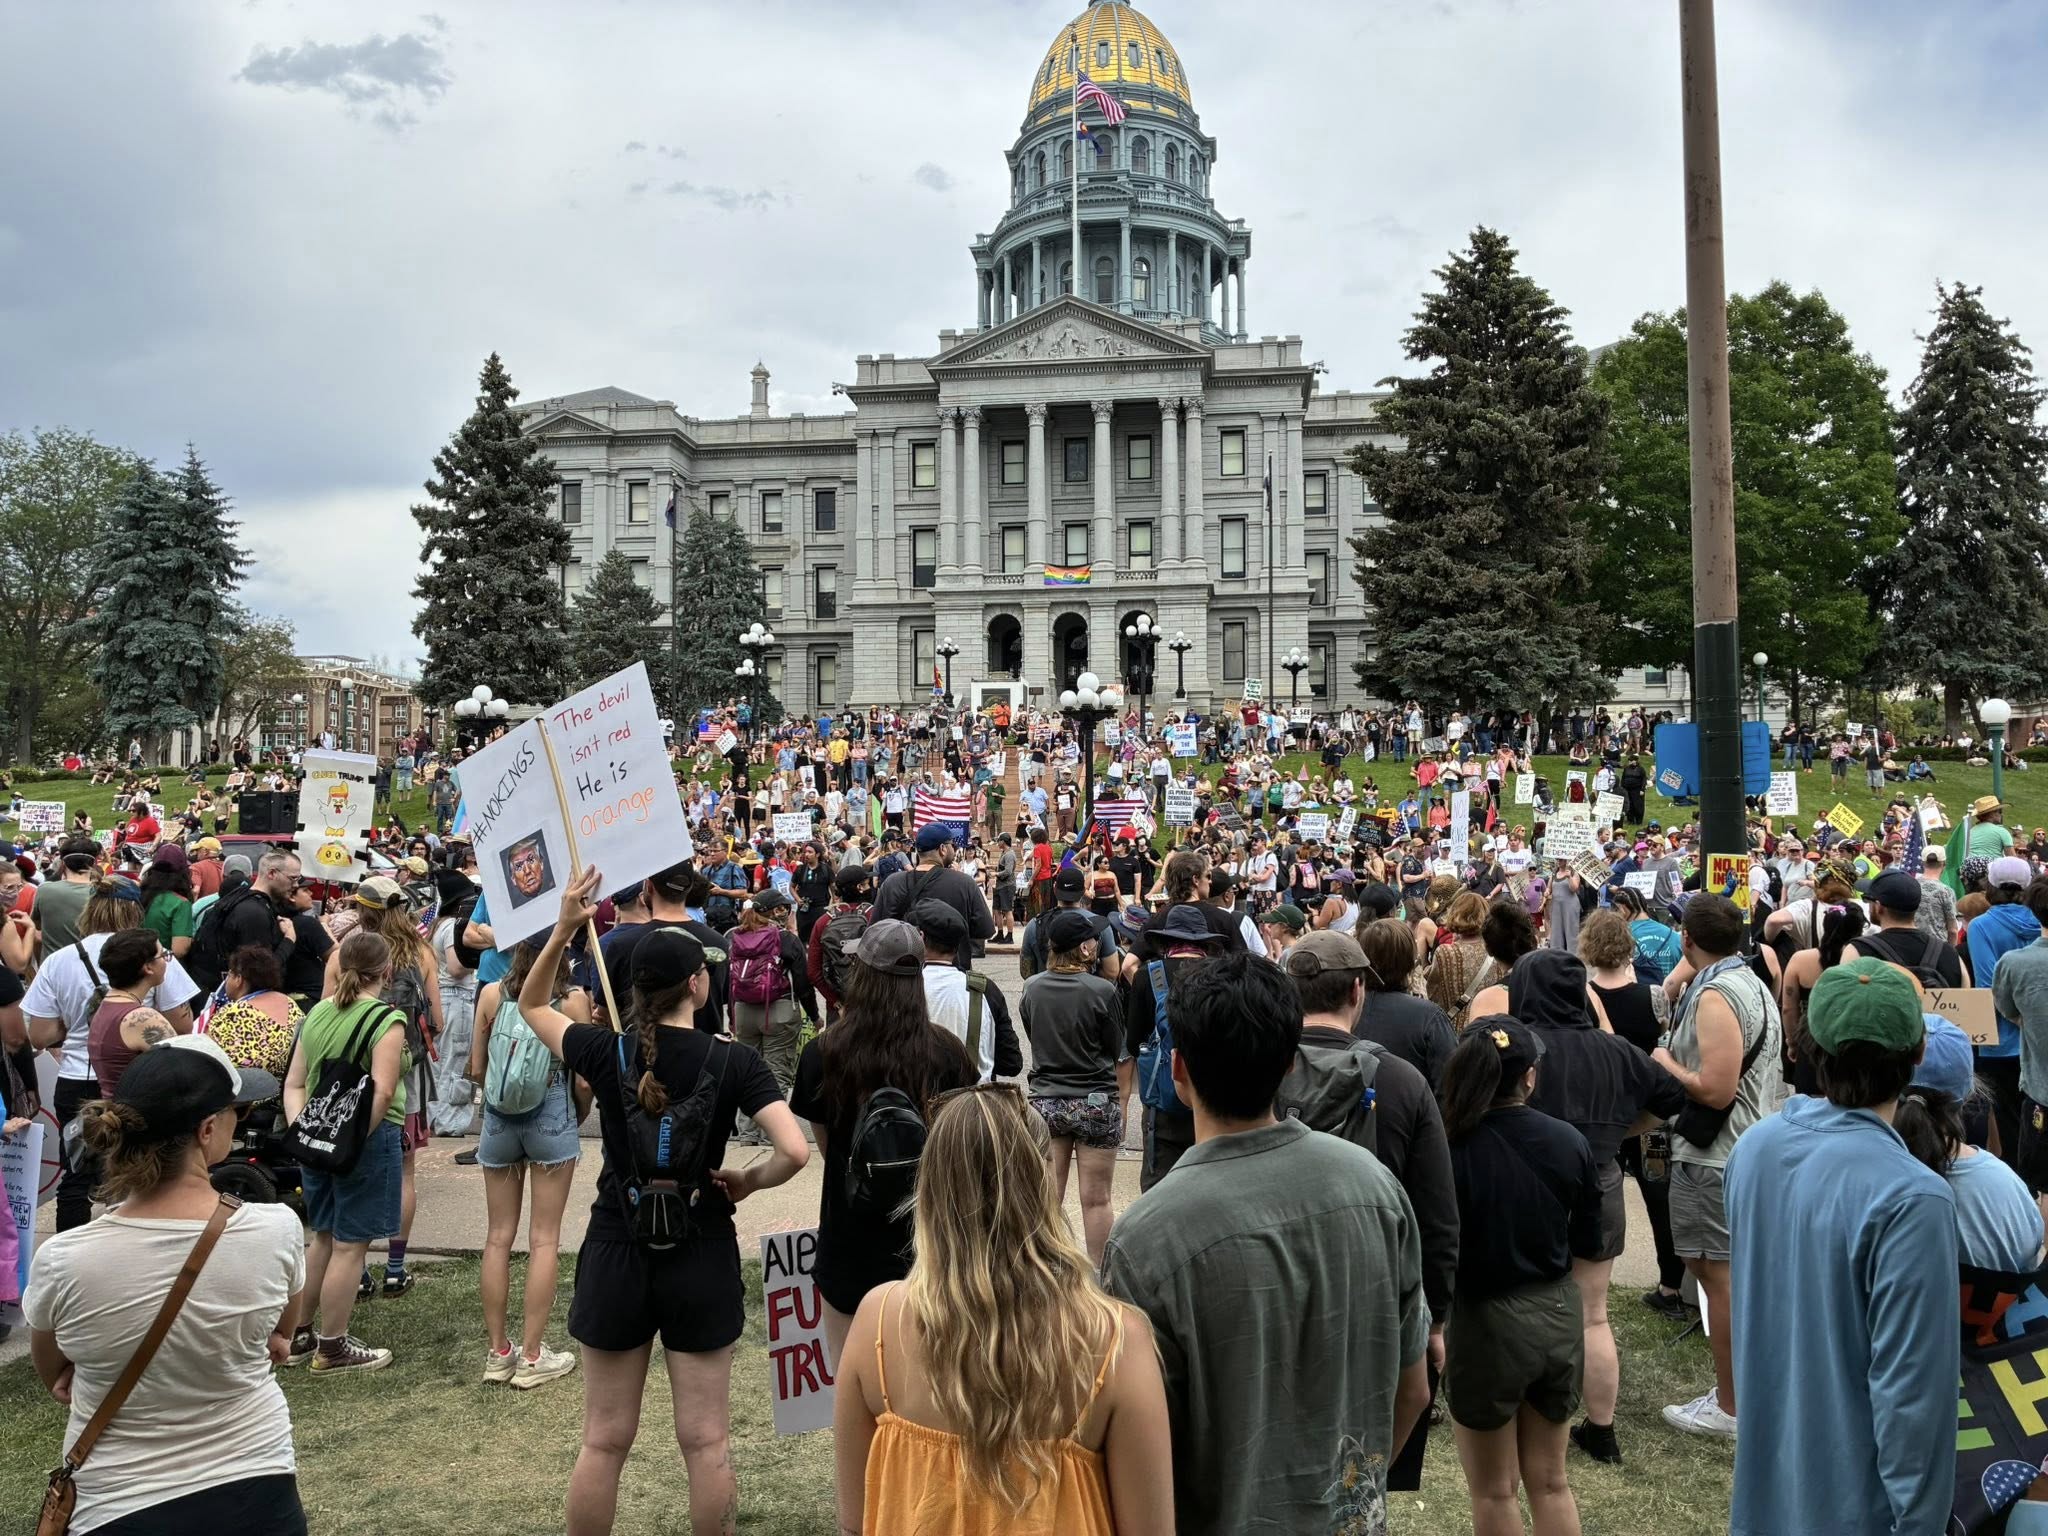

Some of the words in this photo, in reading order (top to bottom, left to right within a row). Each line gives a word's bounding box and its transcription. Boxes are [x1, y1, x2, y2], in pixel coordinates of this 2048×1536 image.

[553, 707, 594, 731] The
[598, 682, 630, 711] devil
[569, 734, 601, 765] isn't
[608, 720, 632, 746] red
[576, 771, 603, 801] He
[609, 761, 629, 784] is
[580, 787, 655, 836] orange
[1592, 870, 1612, 887] 1776
[1713, 858, 1731, 872] NO
